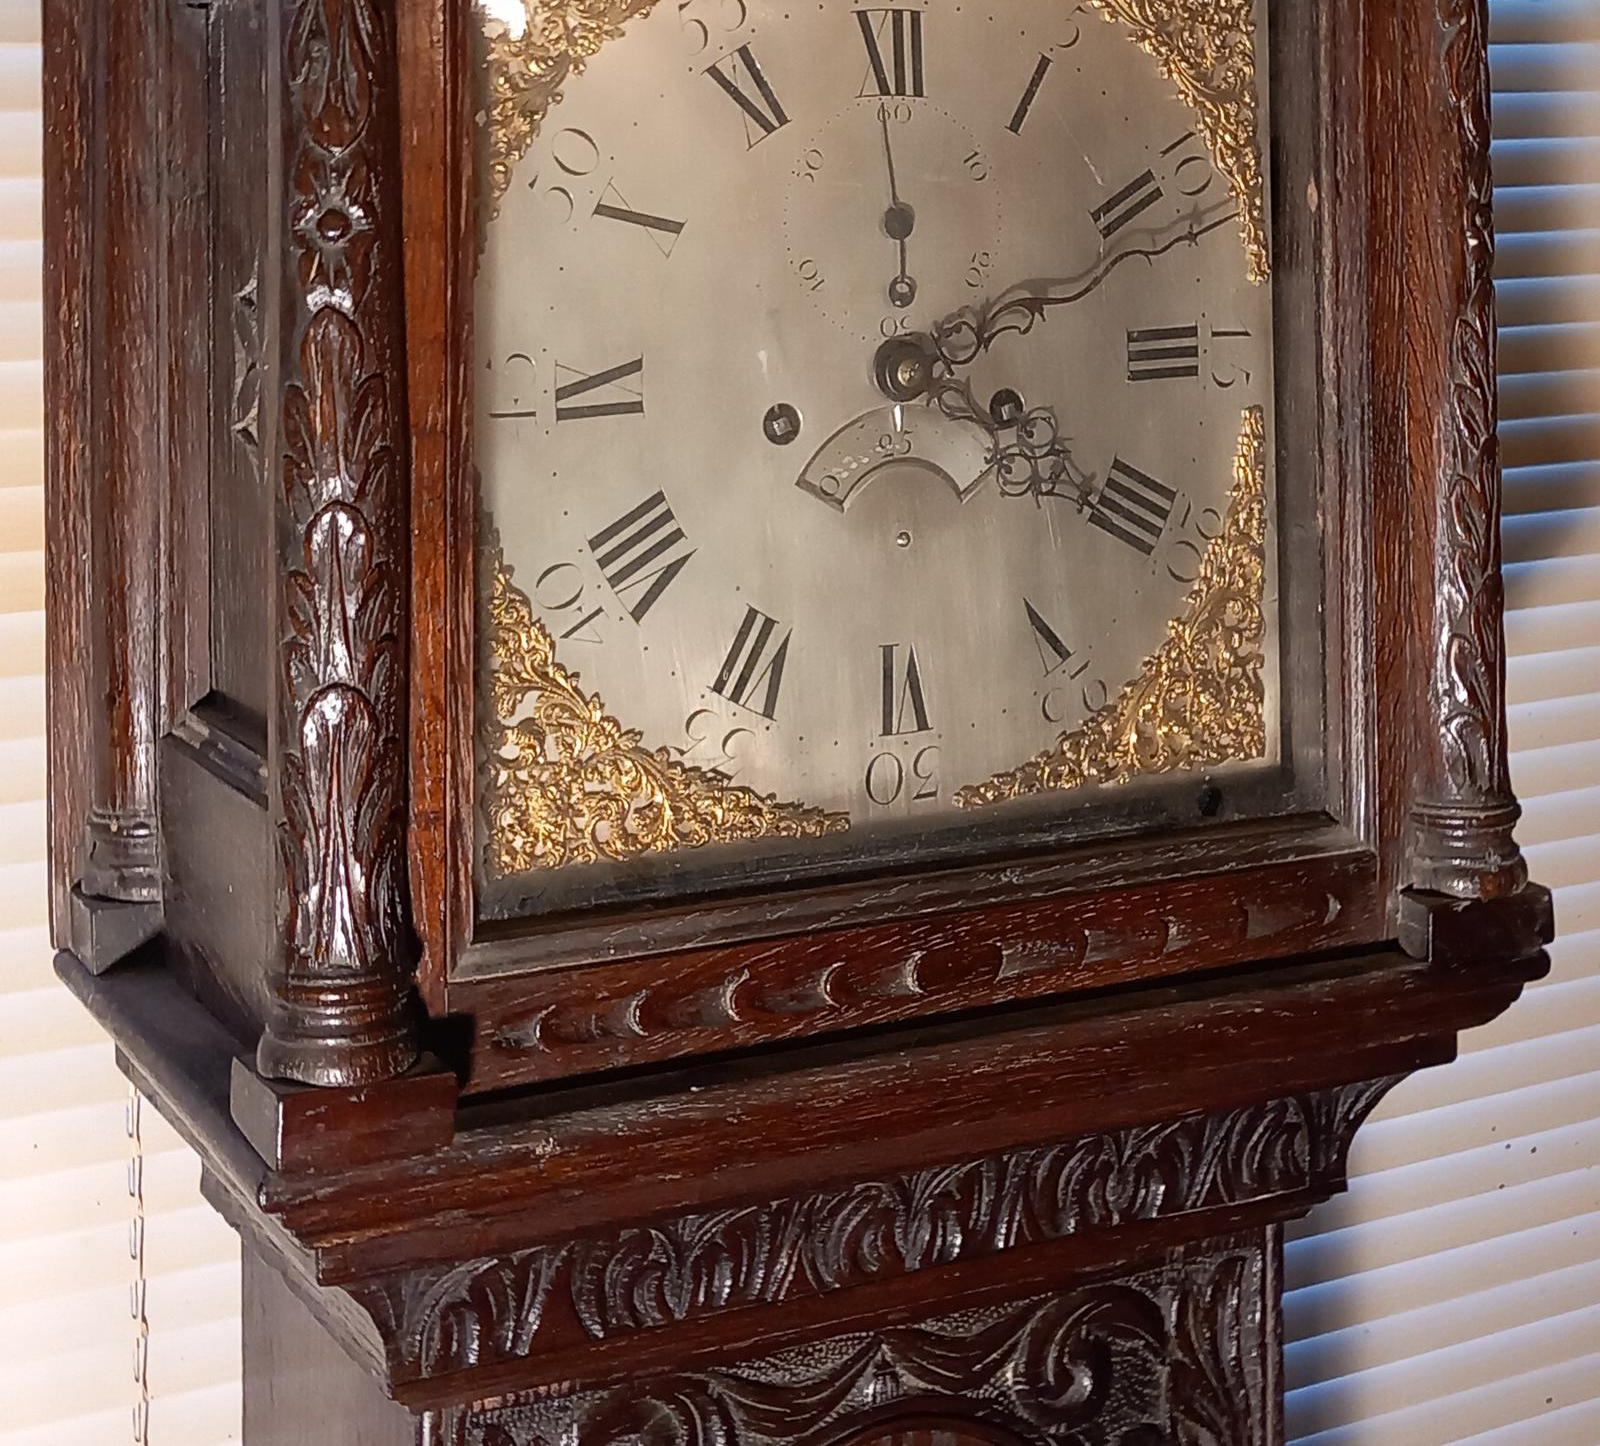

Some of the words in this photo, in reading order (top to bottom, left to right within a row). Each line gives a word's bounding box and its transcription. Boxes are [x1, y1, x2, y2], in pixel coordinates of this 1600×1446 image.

[850, 9, 929, 99] XII
[700, 41, 792, 152] XI
[1088, 167, 1165, 241] II
[554, 352, 646, 426] IX
[1126, 320, 1199, 386] III
[877, 641, 935, 738] VI
